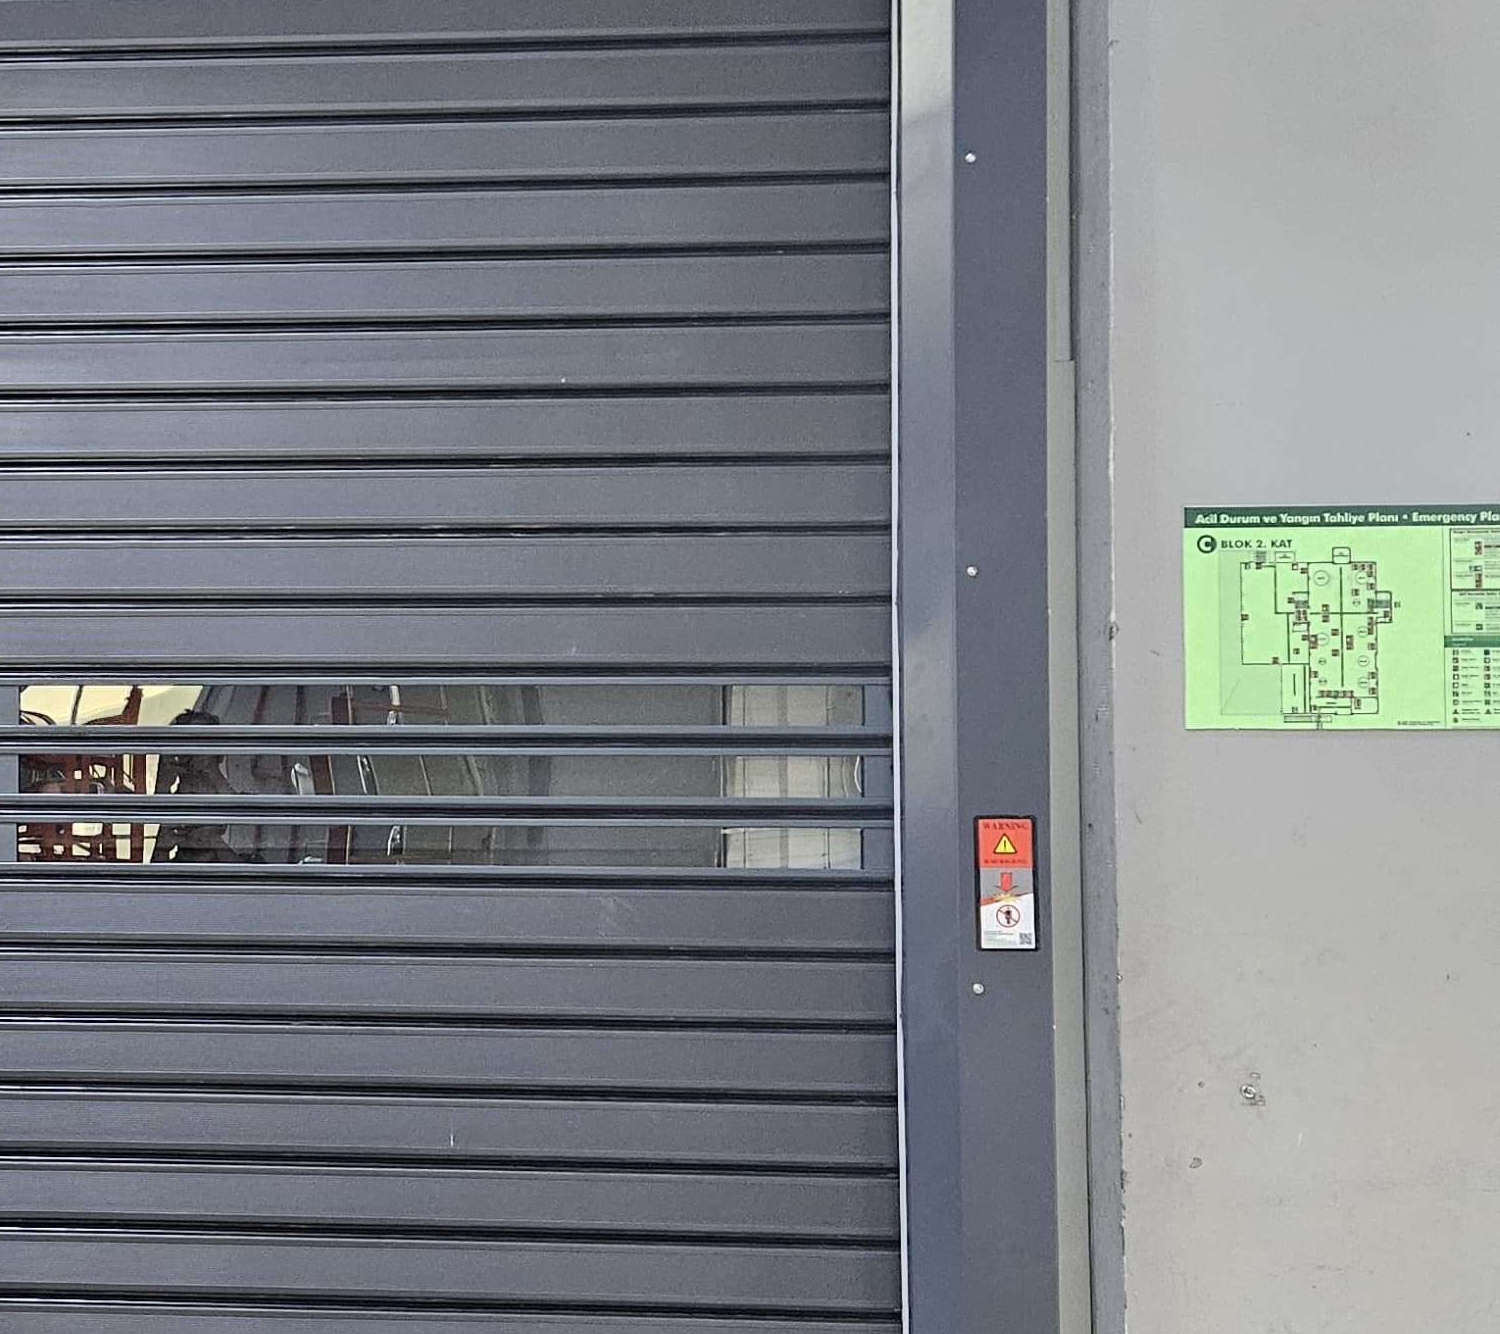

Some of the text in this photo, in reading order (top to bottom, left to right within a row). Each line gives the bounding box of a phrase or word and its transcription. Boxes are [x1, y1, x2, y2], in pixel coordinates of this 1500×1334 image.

[1195, 514, 1217, 524] Acil
[1219, 514, 1260, 524] Durum
[1262, 516, 1277, 524] ve
[1279, 513, 1321, 525] Yangın
[1324, 512, 1365, 525] Tahliye
[1368, 512, 1399, 523] Planı
[1412, 512, 1477, 524] Emergency
[1221, 540, 1252, 548] BLOK
[1256, 540, 1267, 548] 2.
[1271, 540, 1292, 548] KAT
